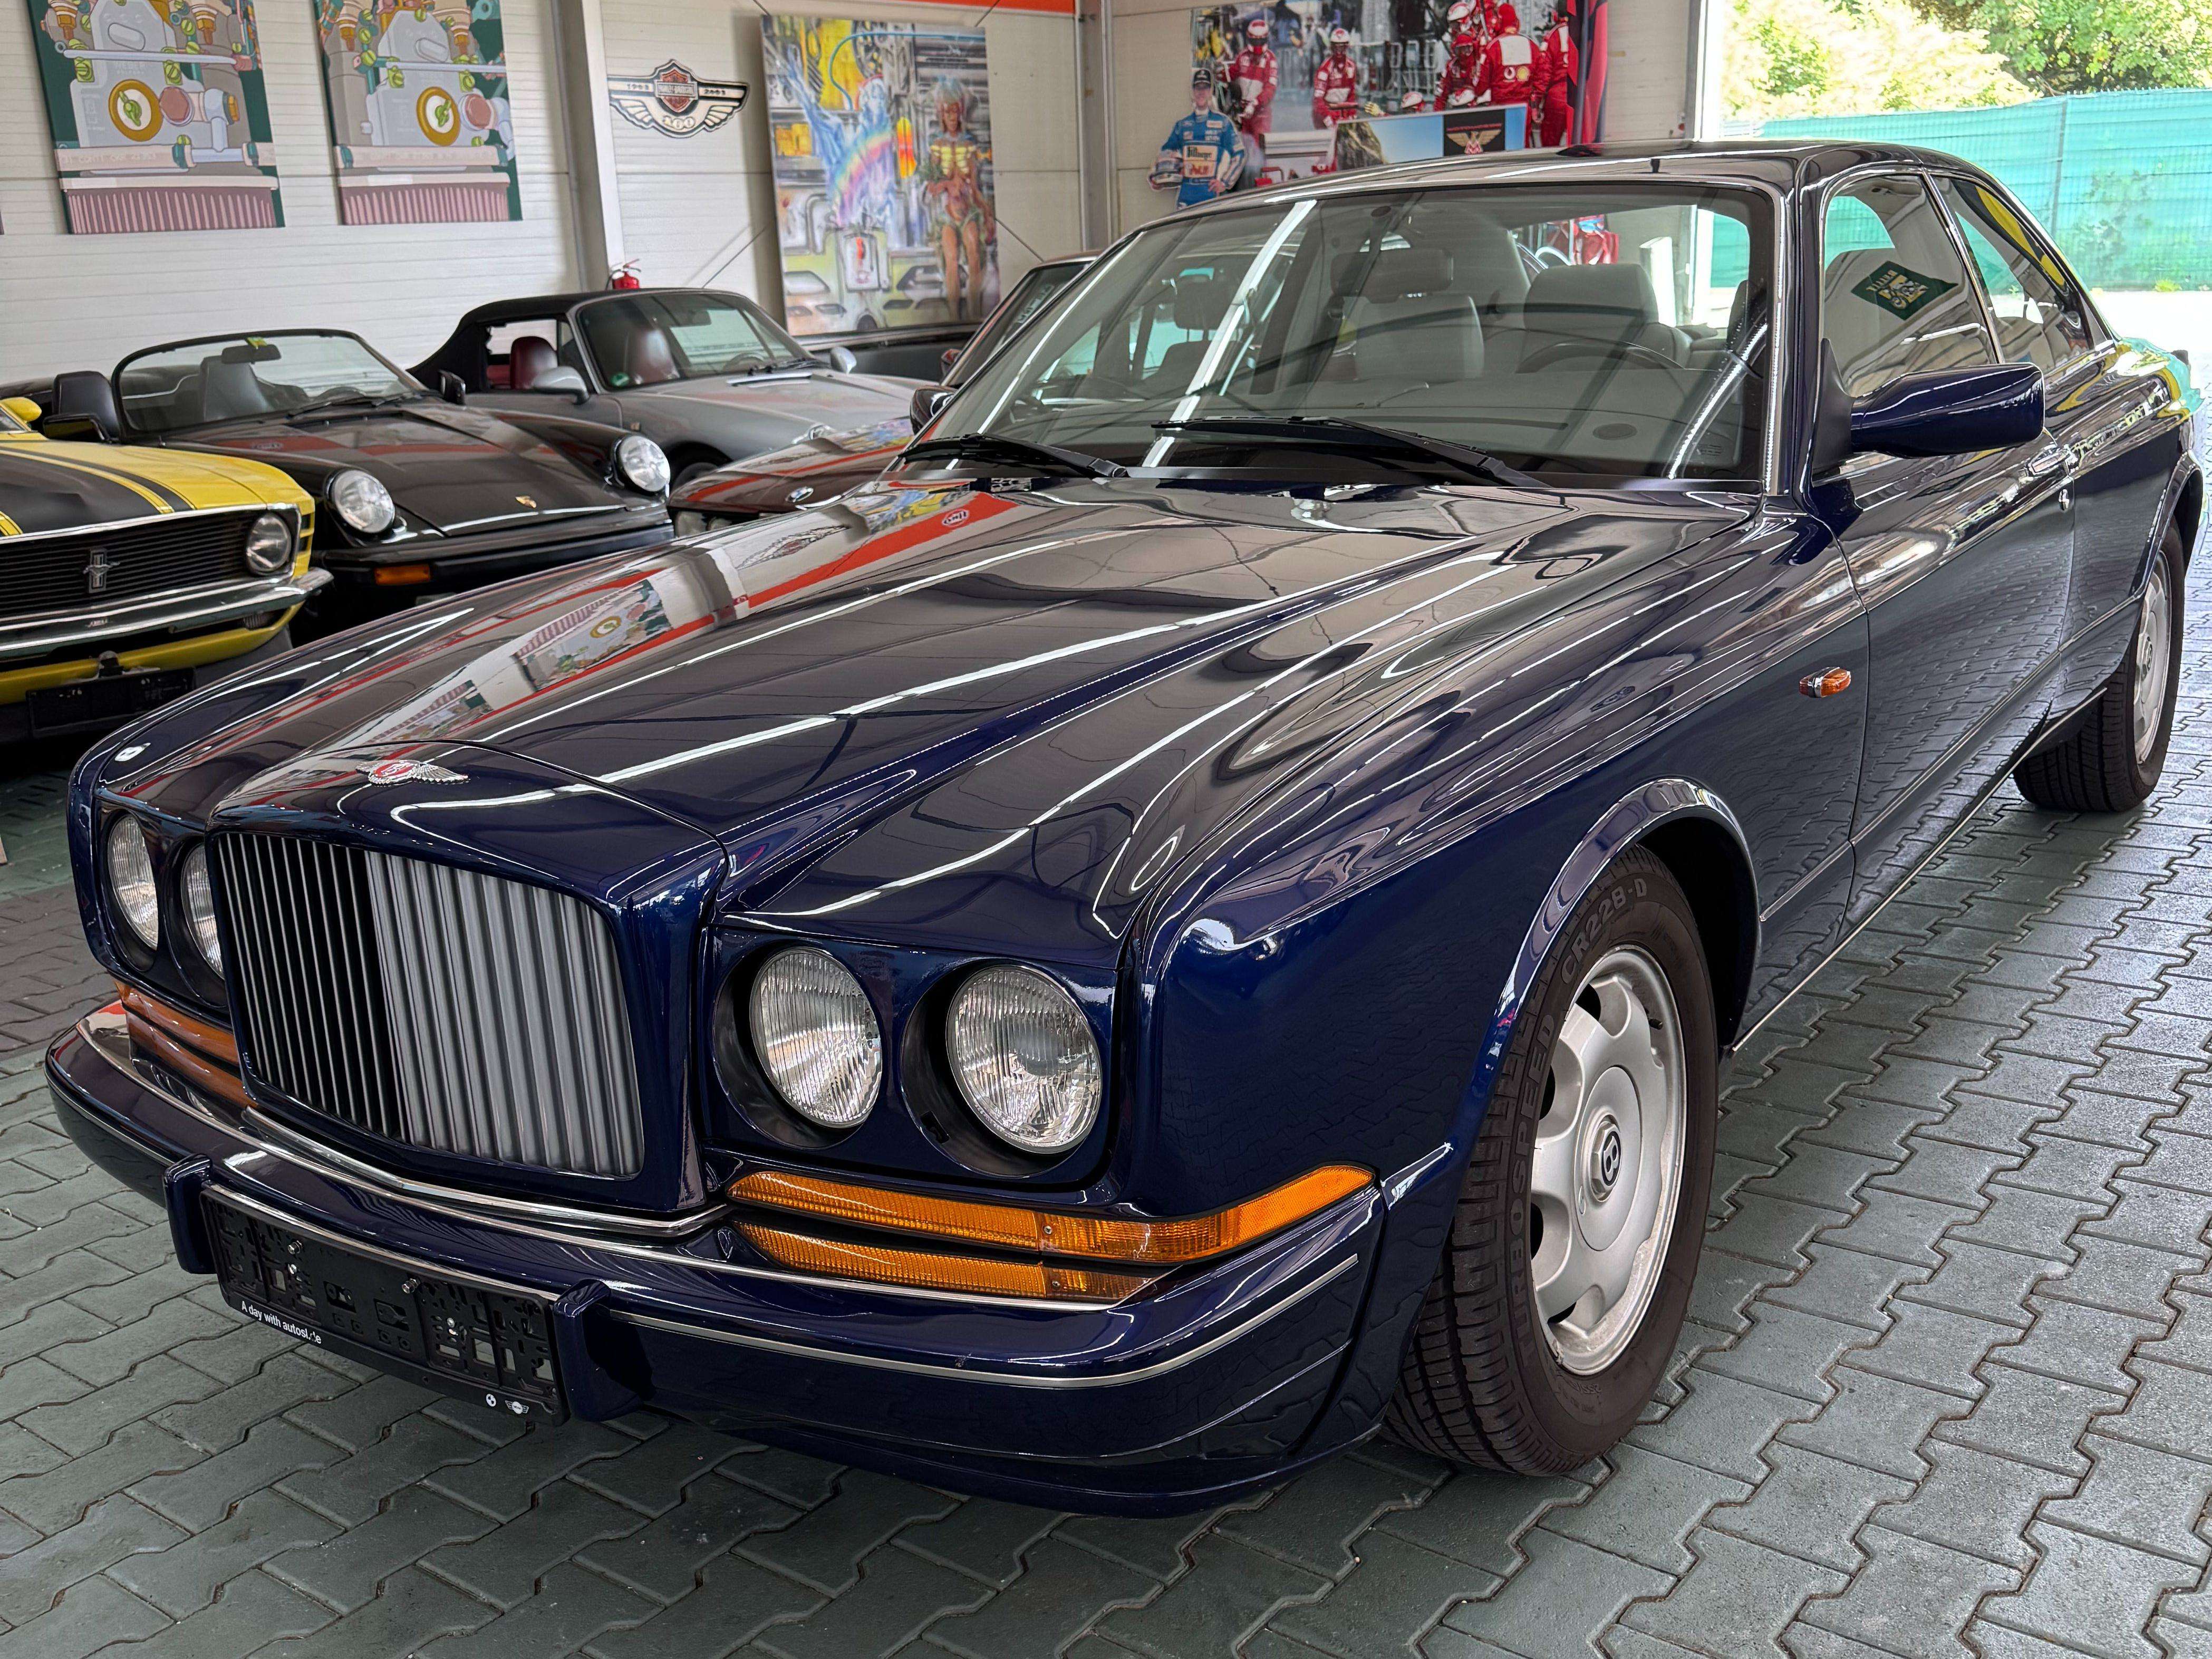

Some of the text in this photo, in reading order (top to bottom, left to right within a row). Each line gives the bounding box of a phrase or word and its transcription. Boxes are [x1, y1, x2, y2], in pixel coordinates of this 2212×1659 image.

[242, 1300, 248, 1313] A
[248, 1305, 262, 1321] day
[264, 1313, 281, 1327] with
